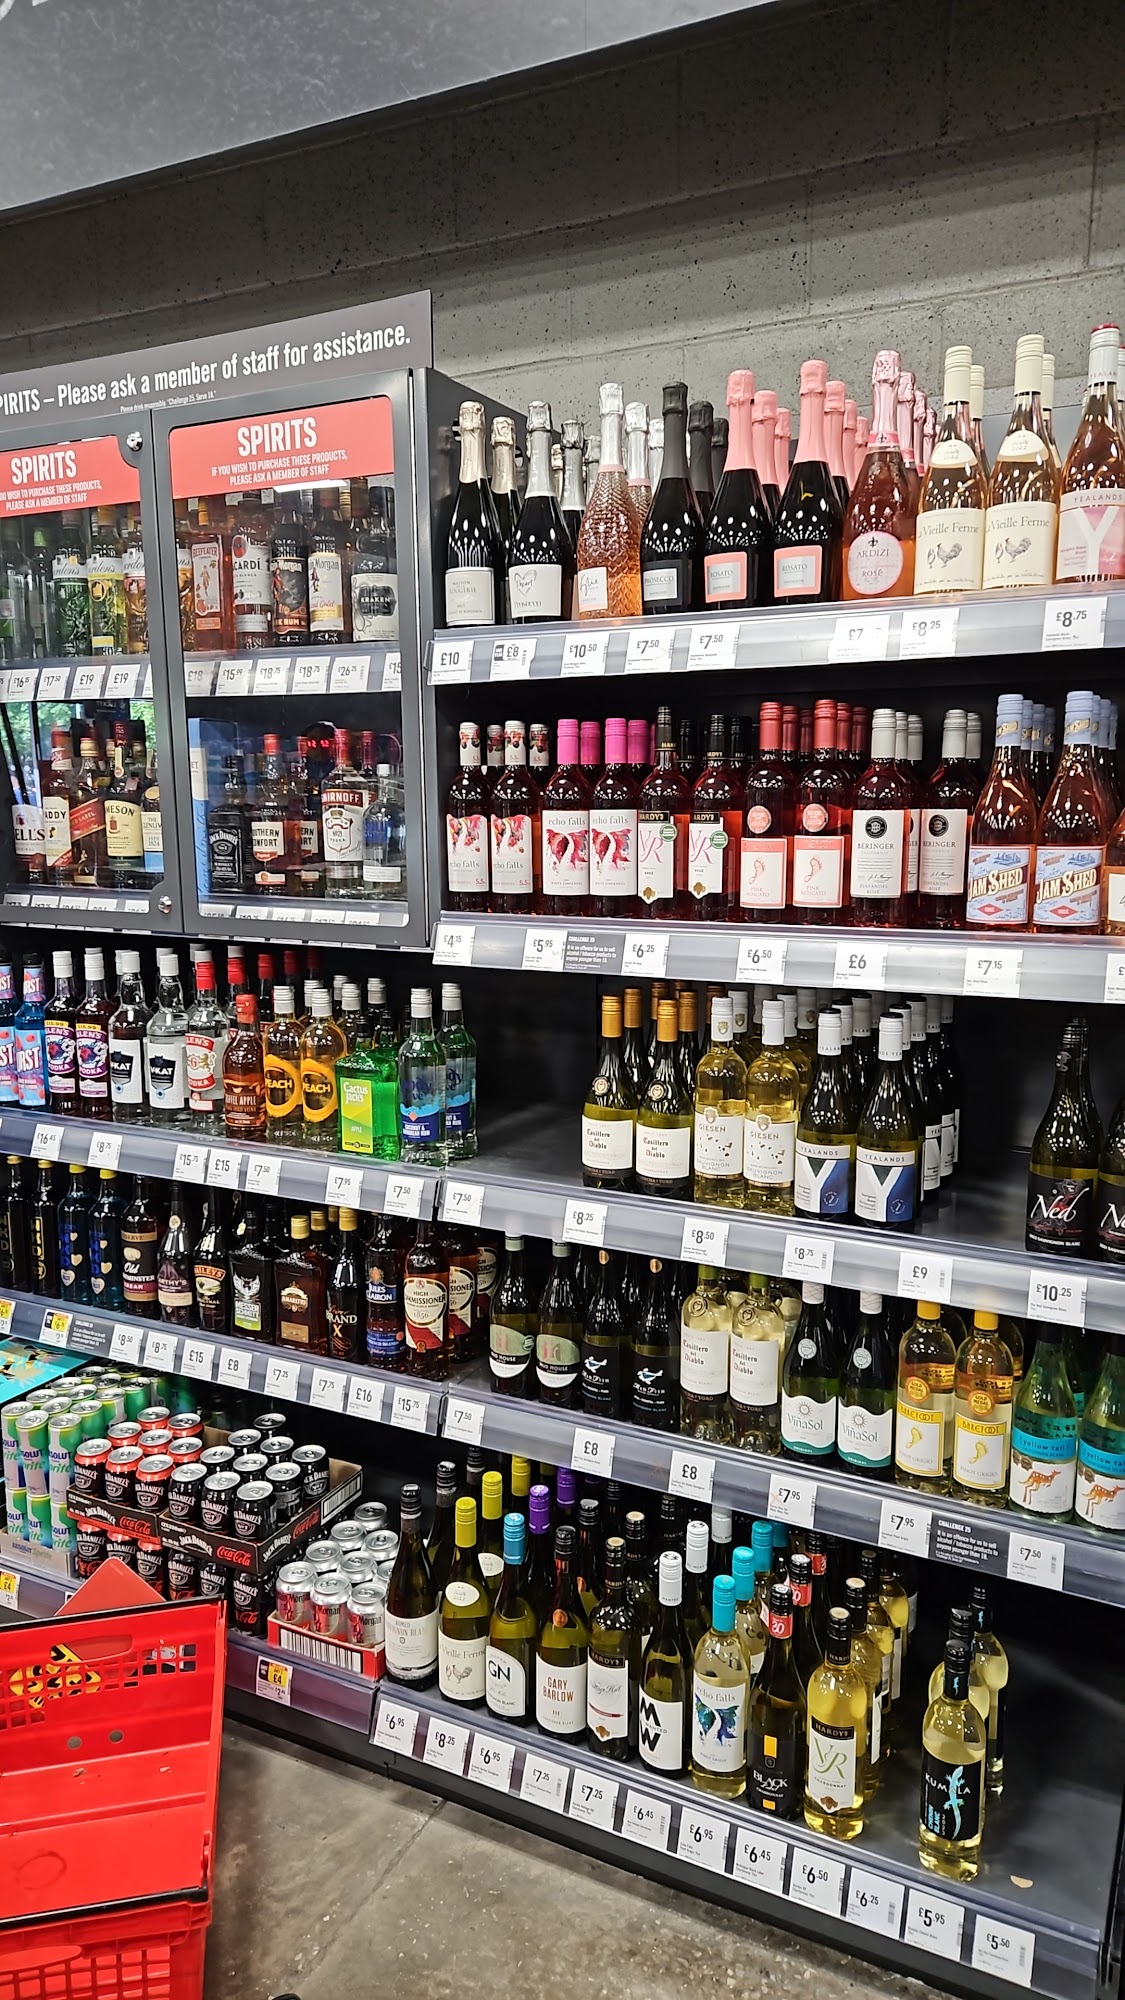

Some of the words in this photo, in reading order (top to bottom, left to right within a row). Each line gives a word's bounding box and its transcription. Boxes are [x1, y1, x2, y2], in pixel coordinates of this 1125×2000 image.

[0, 388, 41, 416] IRITS
[58, 381, 106, 408] Please
[110, 373, 138, 400] ask
[140, 376, 150, 395] a
[155, 361, 218, 392] member
[222, 353, 238, 379] of
[242, 344, 280, 375] staff
[283, 342, 309, 368] for
[313, 325, 411, 363] assistance.
[237, 416, 318, 457] SPIRITS
[11, 450, 77, 485] SPIRITS
[211, 467, 217, 477] IF
[218, 466, 231, 476] YOU
[231, 462, 248, 474] WISH
[249, 461, 257, 471] TO
[257, 456, 291, 470] PURCHASE
[291, 454, 311, 466] THESE
[311, 449, 348, 463] PRODUCTS,
[230, 474, 252, 486] PLEASE
[252, 473, 266, 483] ASK
[266, 472, 272, 481] A
[272, 467, 300, 480] MEMBER
[300, 466, 308, 477] OF
[308, 463, 330, 476] STAFF
[7, 489, 21, 500] WISH
[21, 489, 29, 499] TO
[29, 486, 56, 498] PURCHASE
[56, 485, 72, 495] THESE
[72, 480, 102, 492] PRODUCTS,
[6, 502, 24, 511] PLEASE
[24, 501, 35, 509] ASK
[35, 500, 40, 508] A
[41, 497, 63, 507] MEMBER
[64, 496, 71, 504] OF
[71, 493, 87, 503] STAFF
[923, 524, 949, 536] Vieille
[951, 522, 980, 534] Ferme
[991, 518, 1019, 530] Vieille
[1020, 516, 1050, 528] Ferme
[193, 546, 218, 557] BEEFEATER
[710, 569, 733, 578] ROSATO
[782, 563, 808, 571] ROSATO
[644, 575, 675, 584] PROSECCO
[1056, 610, 1087, 627] £8.75
[848, 628, 864, 641] £7
[912, 620, 941, 637] £8.25
[637, 640, 660, 655] £7.50
[699, 634, 723, 650] £7.50
[506, 645, 519, 658] £8
[569, 643, 597, 659] £10.50
[440, 651, 460, 666] £10
[113, 672, 129, 685] £19
[223, 668, 243, 680] £15.99
[260, 667, 281, 679] £18.75
[299, 665, 321, 678] £18.75
[79, 674, 94, 686] £19
[548, 817, 566, 826] echo
[568, 817, 586, 826] falls
[592, 816, 608, 825] echo
[609, 815, 629, 825] falls
[857, 842, 895, 850] BERINGER
[462, 860, 480, 869] falls
[506, 861, 523, 869] falls
[989, 868, 1023, 896] SHED
[1036, 877, 1061, 903] JAM
[1061, 868, 1097, 896] SHED
[533, 939, 553, 952] £5.95
[632, 943, 655, 958] £6.25
[747, 949, 772, 964] £6.50
[848, 954, 867, 970] £6
[977, 959, 1003, 975] £7.15
[302, 1083, 331, 1093] PEACH
[343, 1082, 368, 1095] Cactus
[239, 1094, 257, 1106] APPLE
[587, 1128, 610, 1138] Casillero
[698, 1123, 726, 1133] GIESEN
[37, 1132, 56, 1145] £16.45
[642, 1136, 668, 1147] Casillero
[750, 1131, 779, 1140] GIESEN
[588, 1141, 607, 1150] Diablo
[800, 1146, 839, 1157] YEALANDS
[645, 1149, 665, 1159] Diablo
[864, 1153, 905, 1163] YEALANDS
[215, 1159, 230, 1172] £15
[254, 1163, 270, 1177] £7.50
[334, 1177, 352, 1190] £7.95
[393, 1185, 411, 1199] £7.50
[453, 1192, 471, 1206] £7.50
[1031, 1187, 1090, 1222] Ned
[573, 1211, 594, 1225] £8.25
[691, 1229, 715, 1244] £8.50
[794, 1247, 814, 1260] £8.75
[124, 1262, 141, 1274] Old
[912, 1265, 928, 1279] £9
[1036, 1284, 1072, 1302] £10.25
[333, 1324, 343, 1337] X
[682, 1340, 708, 1352] Casillero
[189, 1349, 204, 1364] £15
[684, 1354, 704, 1365] Diablo
[227, 1358, 239, 1372] £8
[733, 1363, 754, 1375] Diablo
[273, 1367, 289, 1381] £7.25
[318, 1378, 335, 1392] £7.75
[355, 1387, 372, 1402] £16
[975, 1394, 988, 1402] GOLD
[397, 1397, 420, 1412] £15.75
[454, 1409, 472, 1424] £7.50
[842, 1424, 878, 1442] ViñaSol
[583, 1440, 598, 1456] £8
[682, 1463, 697, 1480] £8
[778, 1487, 801, 1503] £7.95
[890, 1513, 915, 1531] £7.95
[938, 1519, 964, 1532] CHALLENGE
[1020, 1546, 1042, 1561] £7.50
[3, 1582, 11, 1591] £4
[488, 1660, 511, 1683] GN
[273, 1673, 282, 1685] £4
[547, 1676, 568, 1690] GARY
[543, 1686, 574, 1704] BARLOW
[696, 1685, 714, 1701] echo
[715, 1693, 736, 1703] falls
[385, 1714, 405, 1730] £6.95
[814, 1723, 850, 1737] HARDYS
[435, 1731, 456, 1748] £8.25
[480, 1748, 501, 1764] £6.95
[532, 1768, 550, 1783] £7.25
[753, 1771, 789, 1788] BLACK
[924, 1772, 971, 1796] KUMALA
[581, 1784, 603, 1801] £7.25
[633, 1805, 654, 1821] £6.45
[689, 1824, 713, 1843] £6.95
[744, 1844, 771, 1863] £6.45
[802, 1864, 828, 1884] £6.50
[855, 1890, 879, 1907] £6.25
[918, 1907, 945, 1927] £5.95
[986, 1933, 1010, 1950] £5.50
